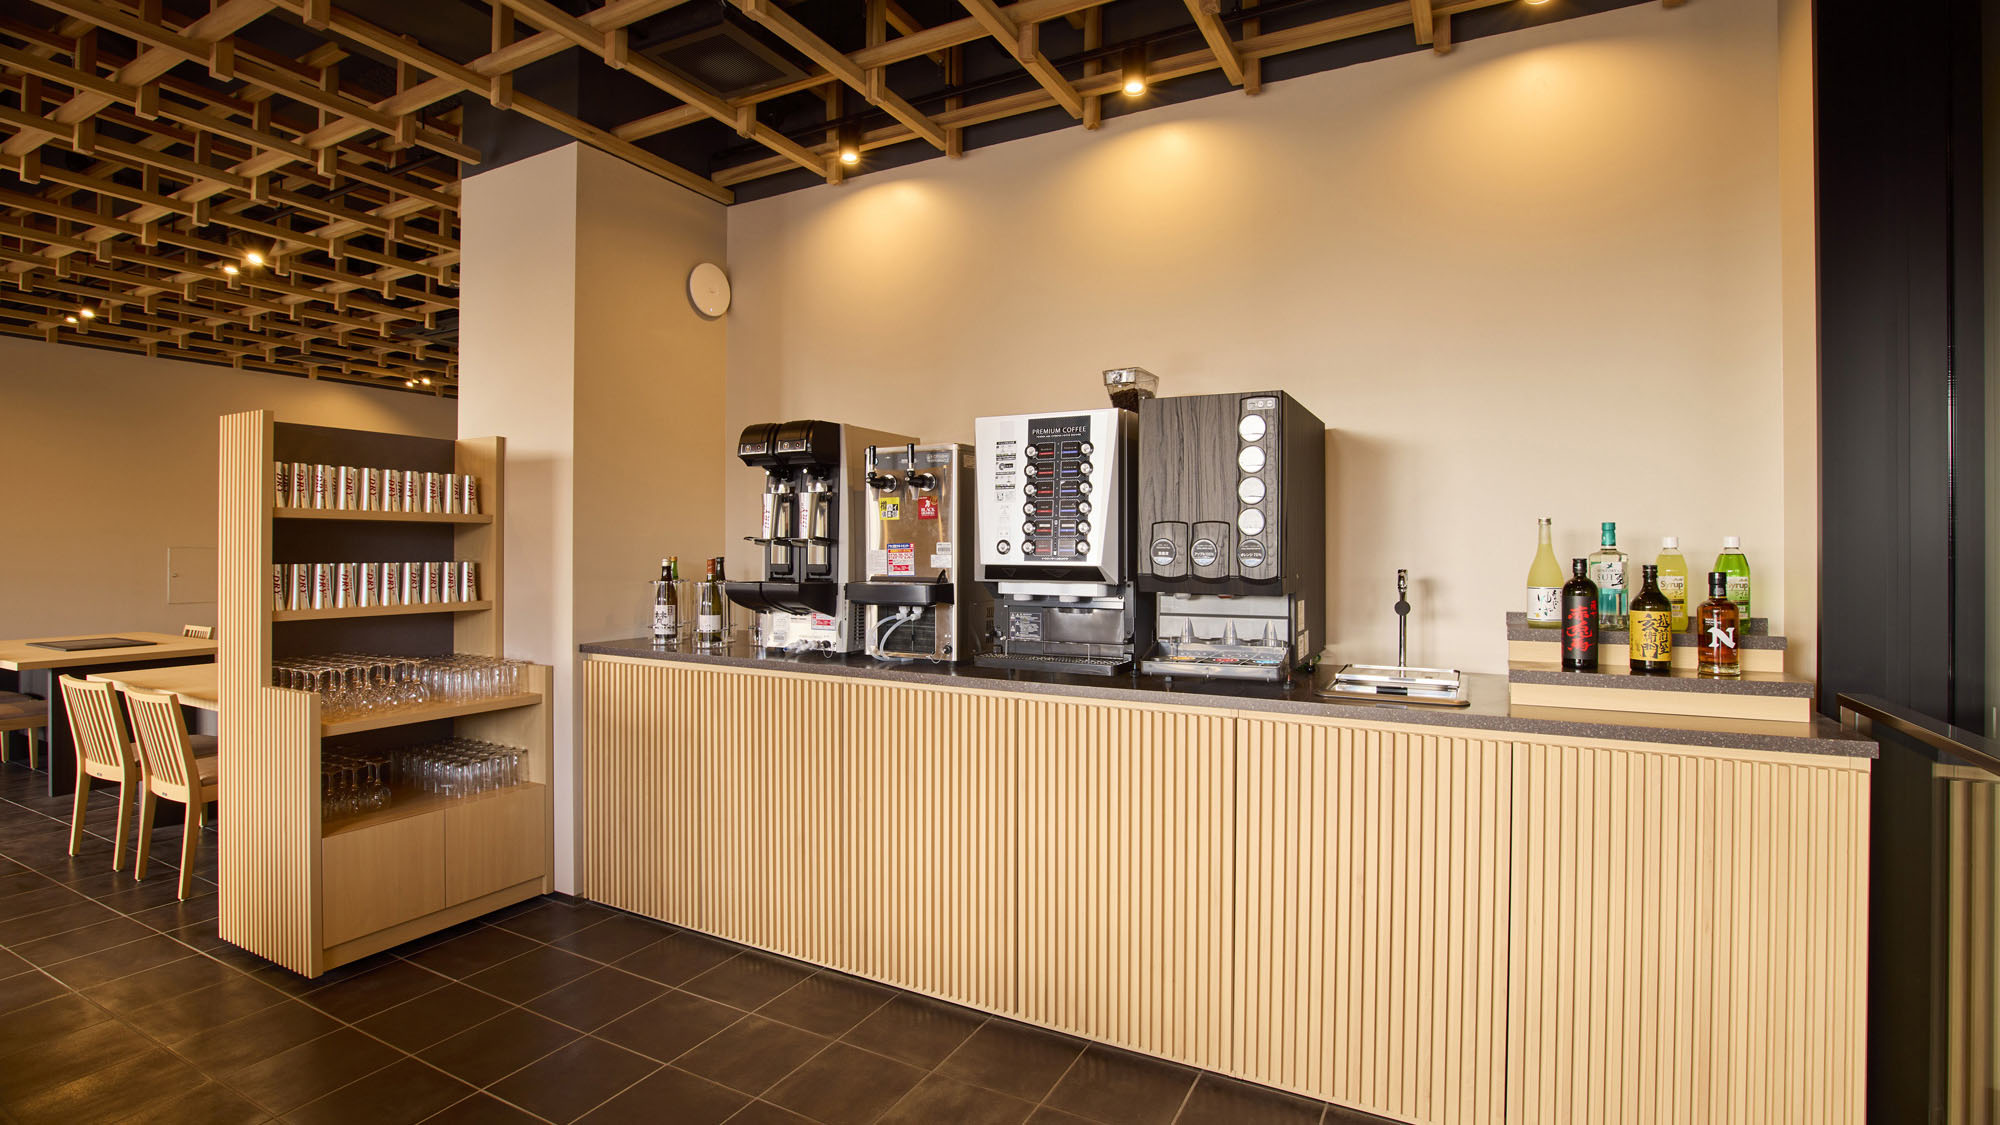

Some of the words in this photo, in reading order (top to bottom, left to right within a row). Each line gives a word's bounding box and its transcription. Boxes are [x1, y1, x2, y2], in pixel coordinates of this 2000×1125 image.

[1032, 427, 1061, 435] PREMIUM
[1062, 425, 1087, 434] COFFEE
[299, 574, 307, 593] DRY
[367, 573, 375, 591] DRY
[1660, 580, 1684, 590] Syrup
